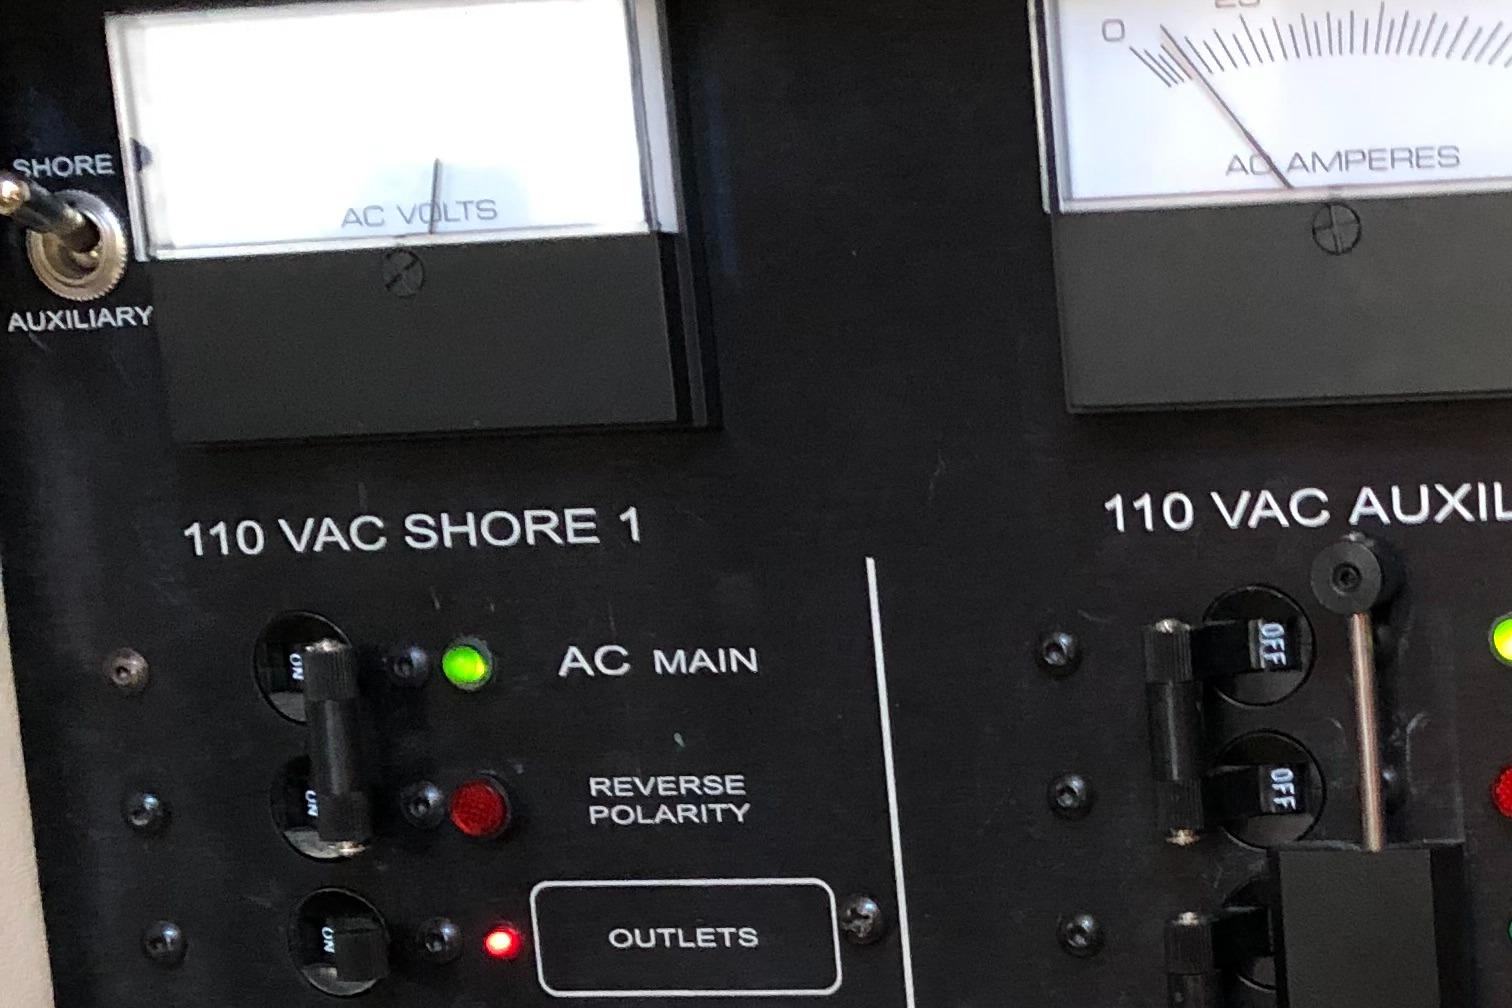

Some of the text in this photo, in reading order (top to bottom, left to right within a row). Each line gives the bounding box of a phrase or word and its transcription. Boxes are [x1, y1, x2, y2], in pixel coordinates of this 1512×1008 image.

[1101, 18, 1126, 42] 0
[12, 152, 116, 178] SHORE
[1226, 145, 1460, 176] AC AMPERES
[341, 197, 499, 228] AC VOLTS
[7, 305, 154, 332] AUXILIARY
[1104, 491, 1194, 532] 110
[1210, 487, 1331, 529] VAC
[183, 506, 640, 556] 110 VAC SHORE 1
[1261, 622, 1287, 667] OFF
[289, 653, 305, 681] ON
[558, 644, 758, 677] AC MAIN
[589, 774, 746, 797] REVERSE
[1270, 767, 1296, 810] OFF
[588, 802, 751, 826] POLARITY
[321, 926, 336, 954] ON
[608, 927, 759, 948] OUTLETS
